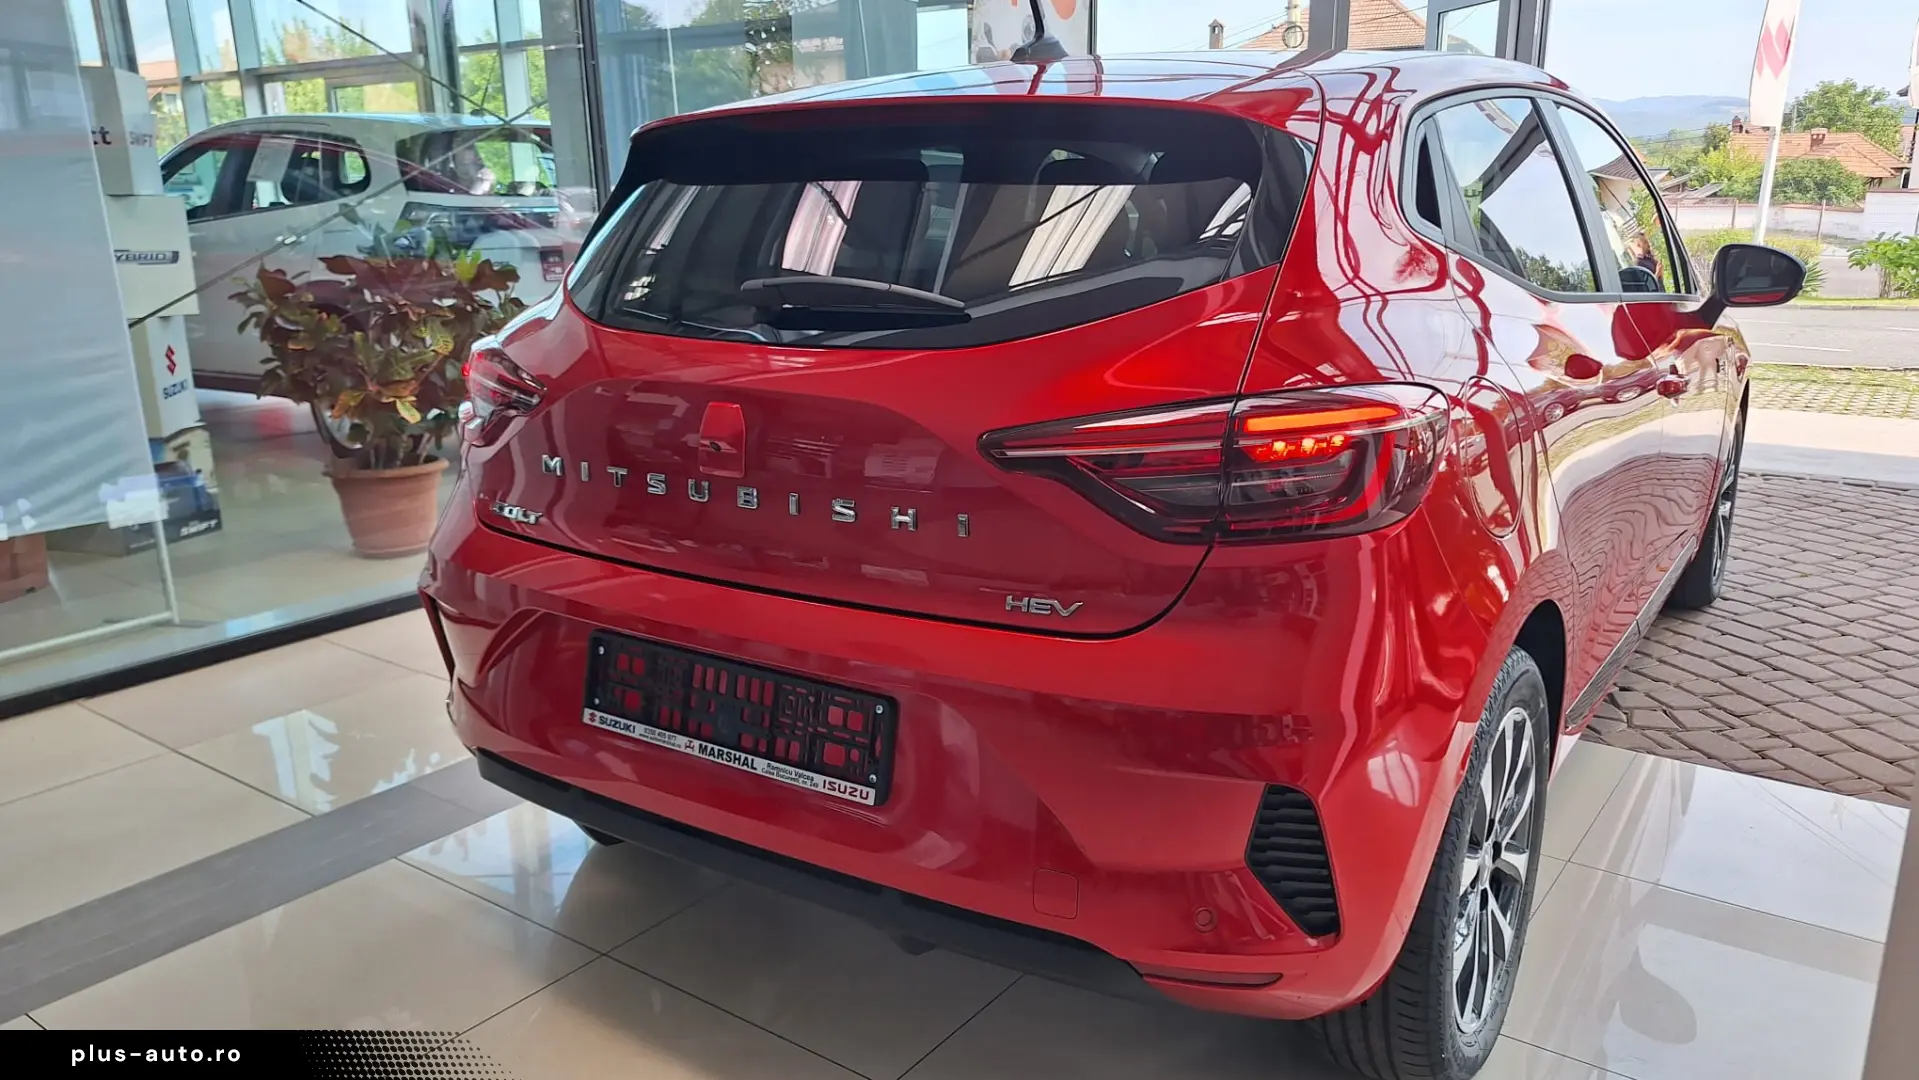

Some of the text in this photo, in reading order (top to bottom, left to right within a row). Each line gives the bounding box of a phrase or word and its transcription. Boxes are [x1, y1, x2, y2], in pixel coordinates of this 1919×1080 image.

[114, 252, 168, 262] YBRID
[163, 379, 188, 400] SUZUKI
[541, 453, 970, 538] MITSUBISHI
[1005, 594, 1084, 617] HEV
[599, 715, 636, 734] SUZUKI
[699, 743, 758, 771] MARSHAL
[822, 779, 869, 801] ISUZU
